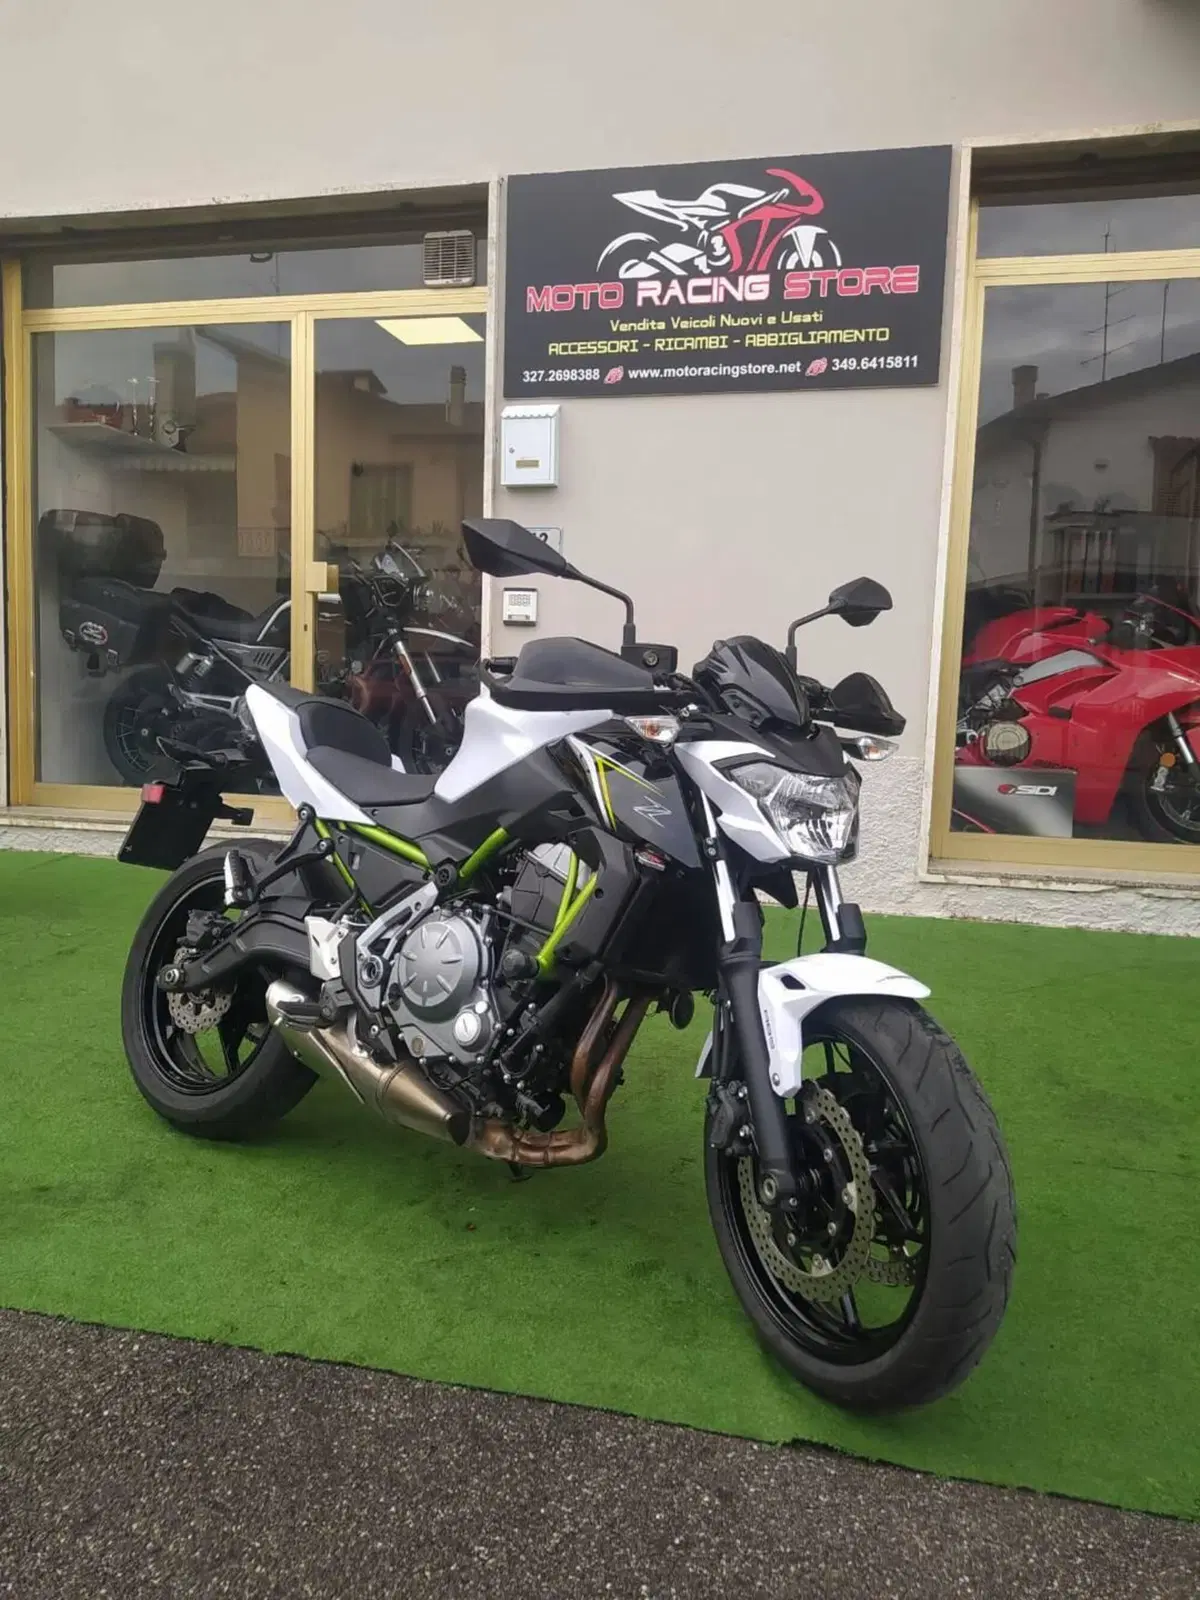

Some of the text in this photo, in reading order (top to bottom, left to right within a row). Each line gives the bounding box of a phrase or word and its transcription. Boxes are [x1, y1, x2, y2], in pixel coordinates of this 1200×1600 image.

[526, 265, 920, 313] MOTO RACING STORE
[610, 309, 824, 332] Vendita Veicoli Nuovi e Usati
[548, 339, 639, 356] ACCESSORI
[654, 335, 728, 352] RICAMBI
[745, 327, 890, 348] ABBIGLIAMENTO
[522, 355, 919, 383] 327.2698388 www.motoracingstore.net 349.6415811
